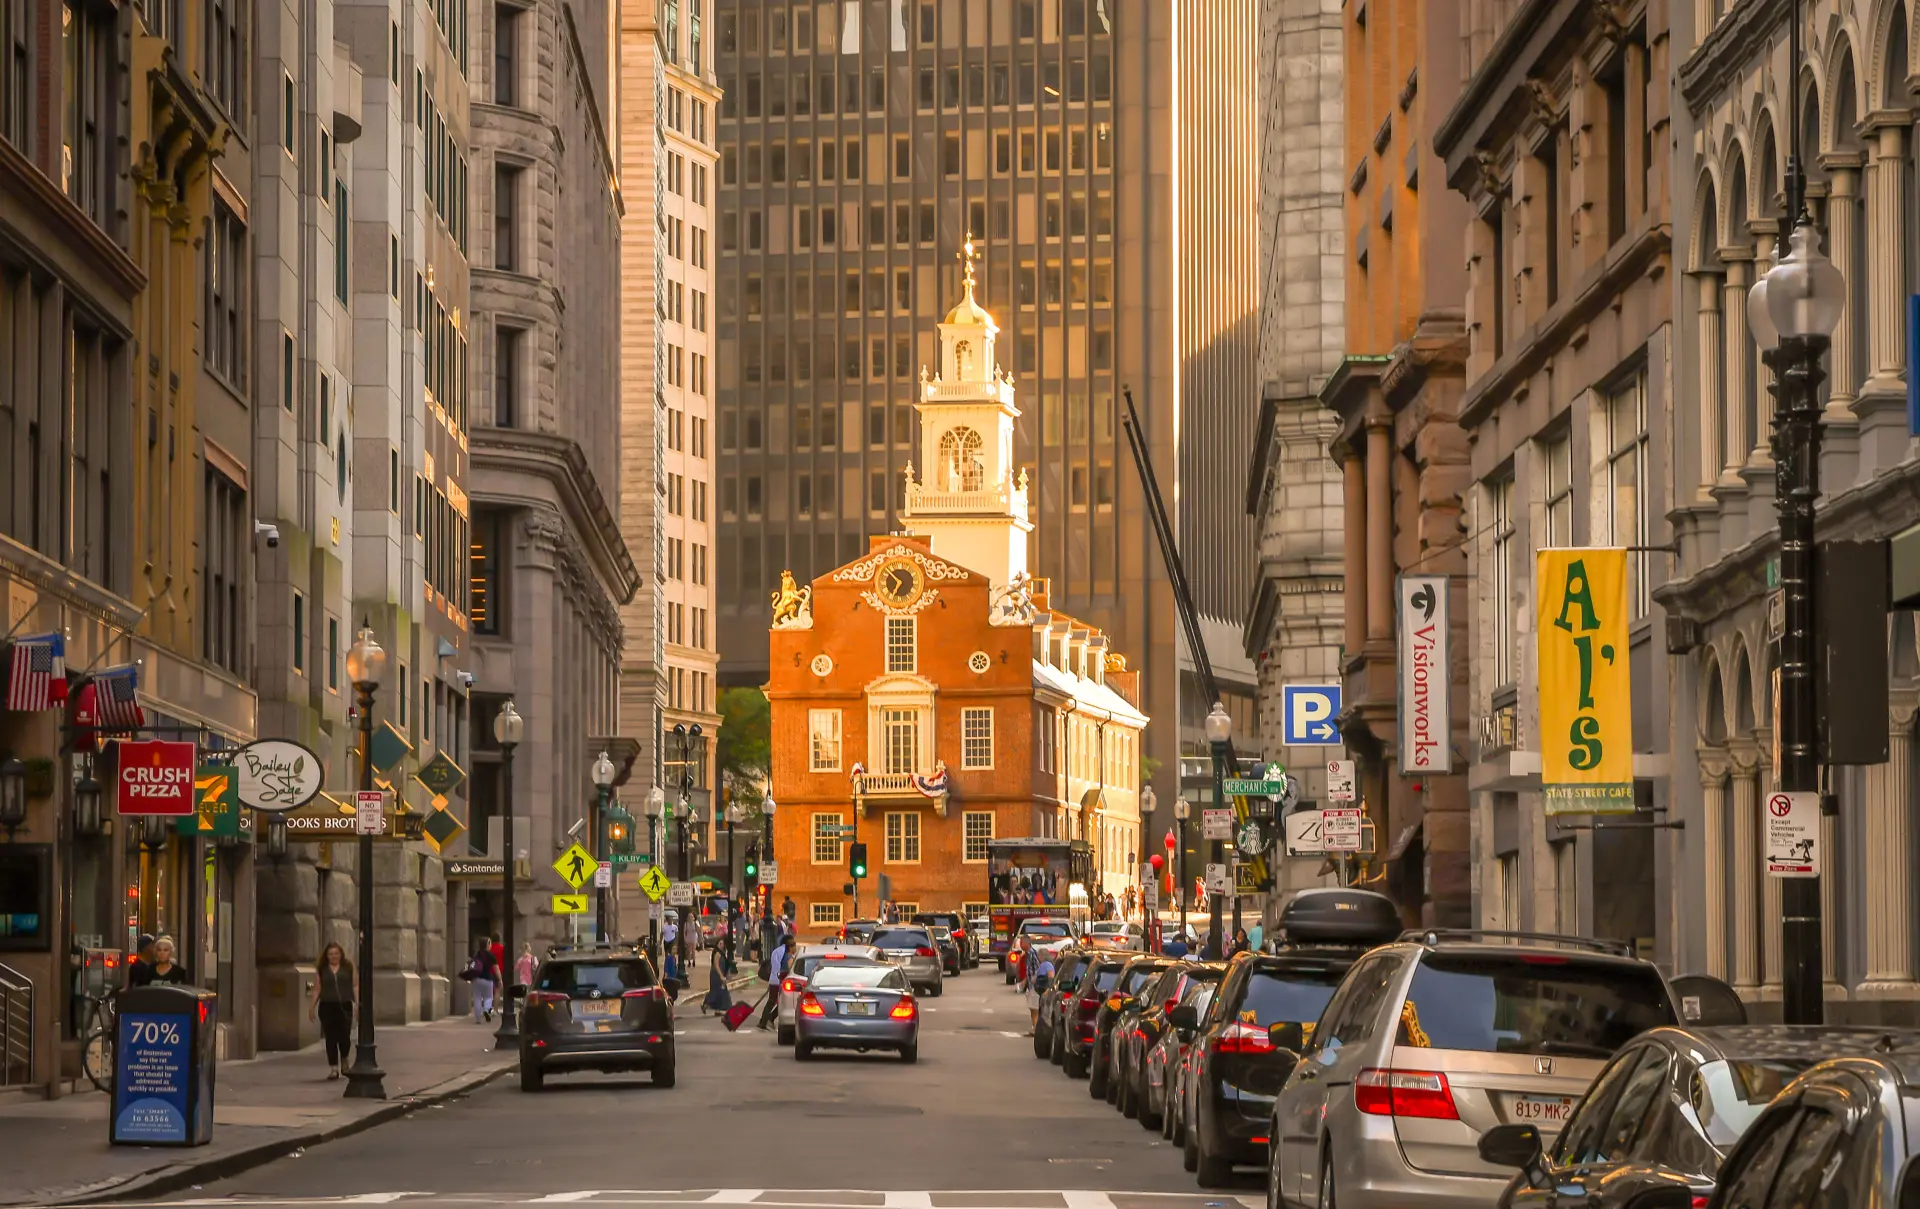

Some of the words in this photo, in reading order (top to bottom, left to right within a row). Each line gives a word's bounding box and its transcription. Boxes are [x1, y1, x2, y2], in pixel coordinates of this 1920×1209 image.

[1413, 622, 1438, 767] Visionworks
[245, 749, 293, 783] Bailey
[122, 766, 190, 783] CRUSH
[432, 768, 448, 781] 75
[129, 784, 181, 797] PIZZA
[259, 772, 304, 804] Sage
[1225, 781, 1268, 793] MERCHANTS
[1546, 787, 1573, 798] STATE
[1575, 787, 1606, 798] STREET
[287, 817, 321, 829] OOKS
[324, 817, 387, 829] BROTS
[618, 855, 641, 863] KILBY
[130, 1022, 179, 1044] 70%
[1516, 1101, 1541, 1118] 819
[1544, 1103, 1570, 1120] MK2
[144, 1114, 169, 1122] 63566
